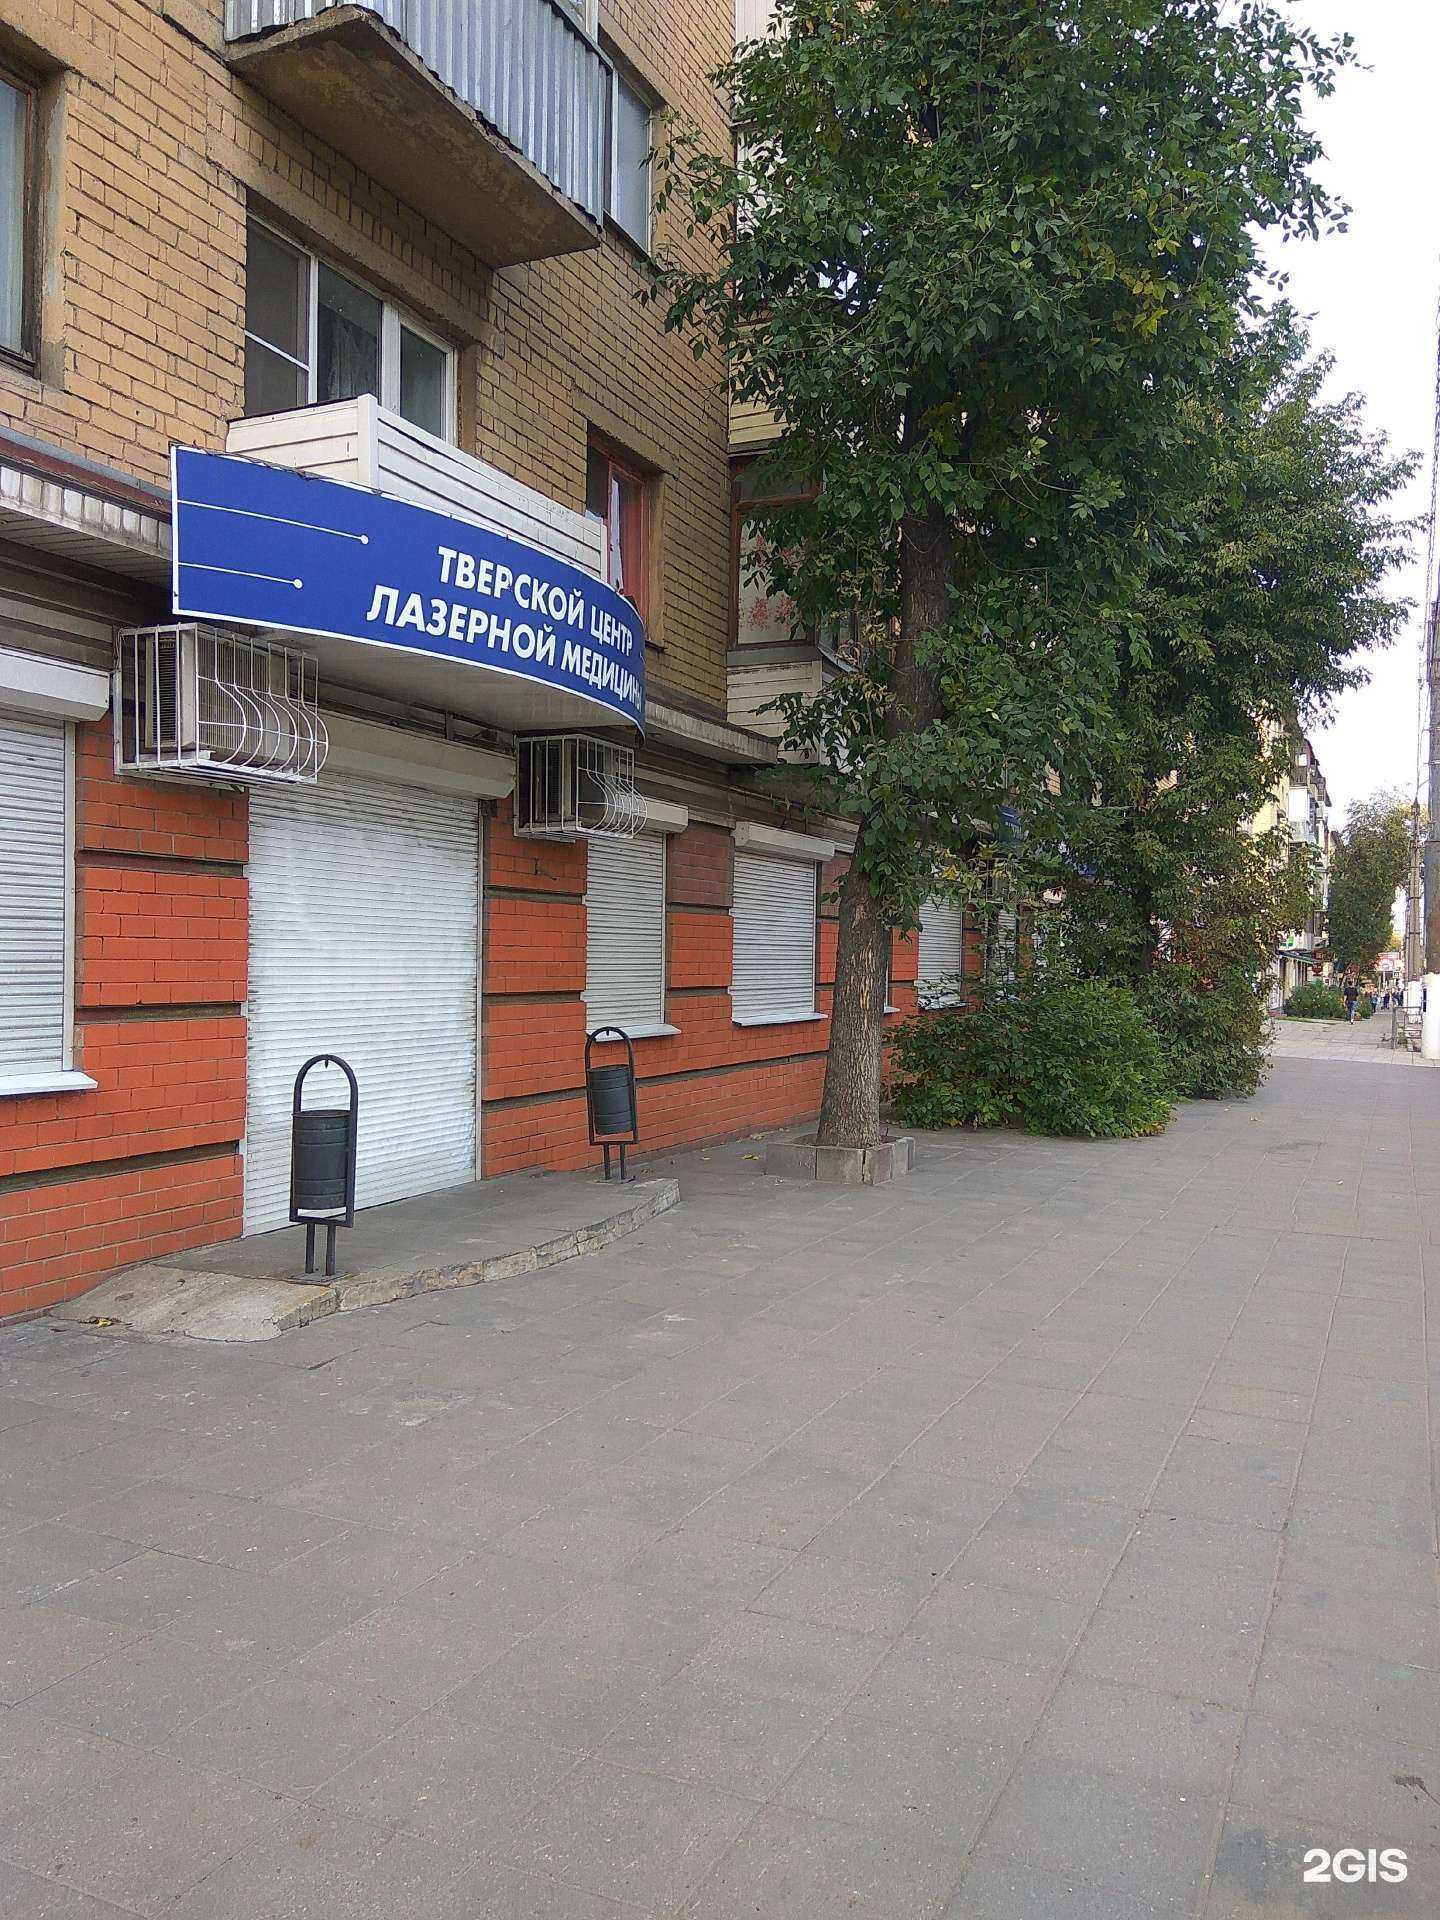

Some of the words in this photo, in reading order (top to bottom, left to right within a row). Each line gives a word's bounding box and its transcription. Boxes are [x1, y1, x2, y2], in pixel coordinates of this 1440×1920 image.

[366, 584, 556, 666] ЛАЗЕРНОЙ
[438, 546, 585, 629] ТВЕРСКОЙ
[590, 605, 633, 656] ЦЕНТР
